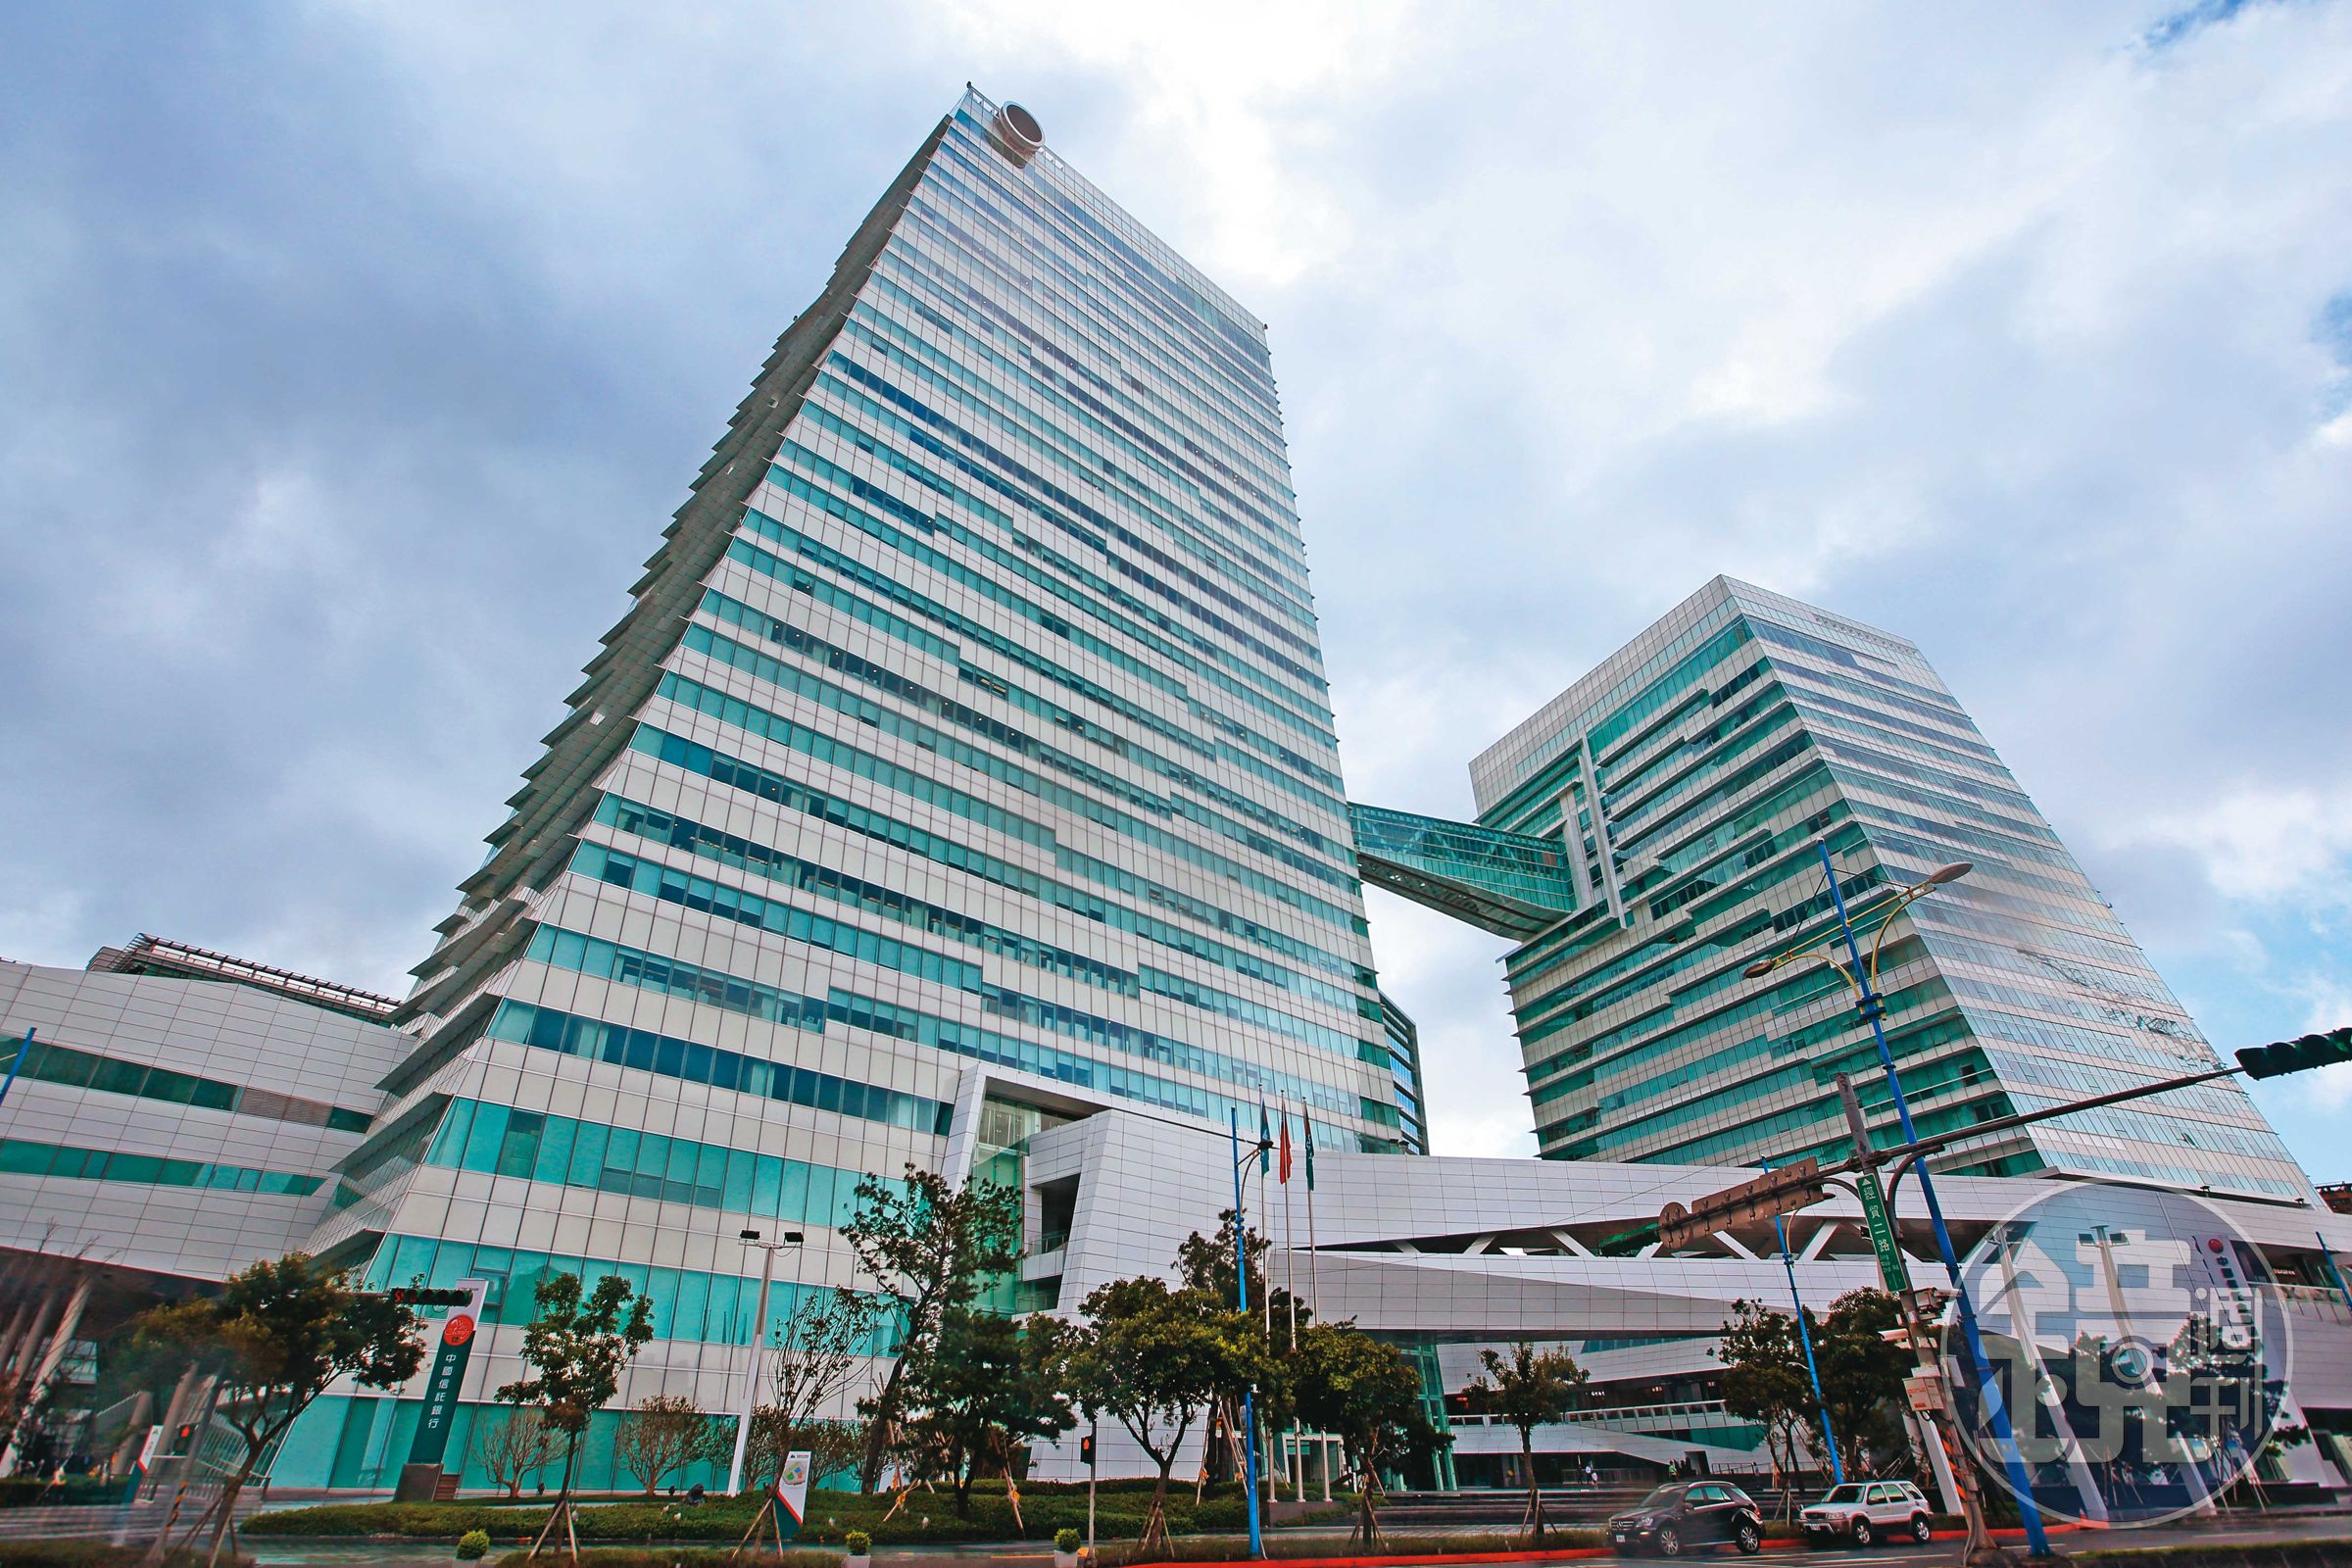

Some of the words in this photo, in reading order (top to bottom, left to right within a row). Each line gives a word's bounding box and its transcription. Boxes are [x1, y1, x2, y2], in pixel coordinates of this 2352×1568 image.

[428, 1354, 457, 1428] 中國信託銀行
